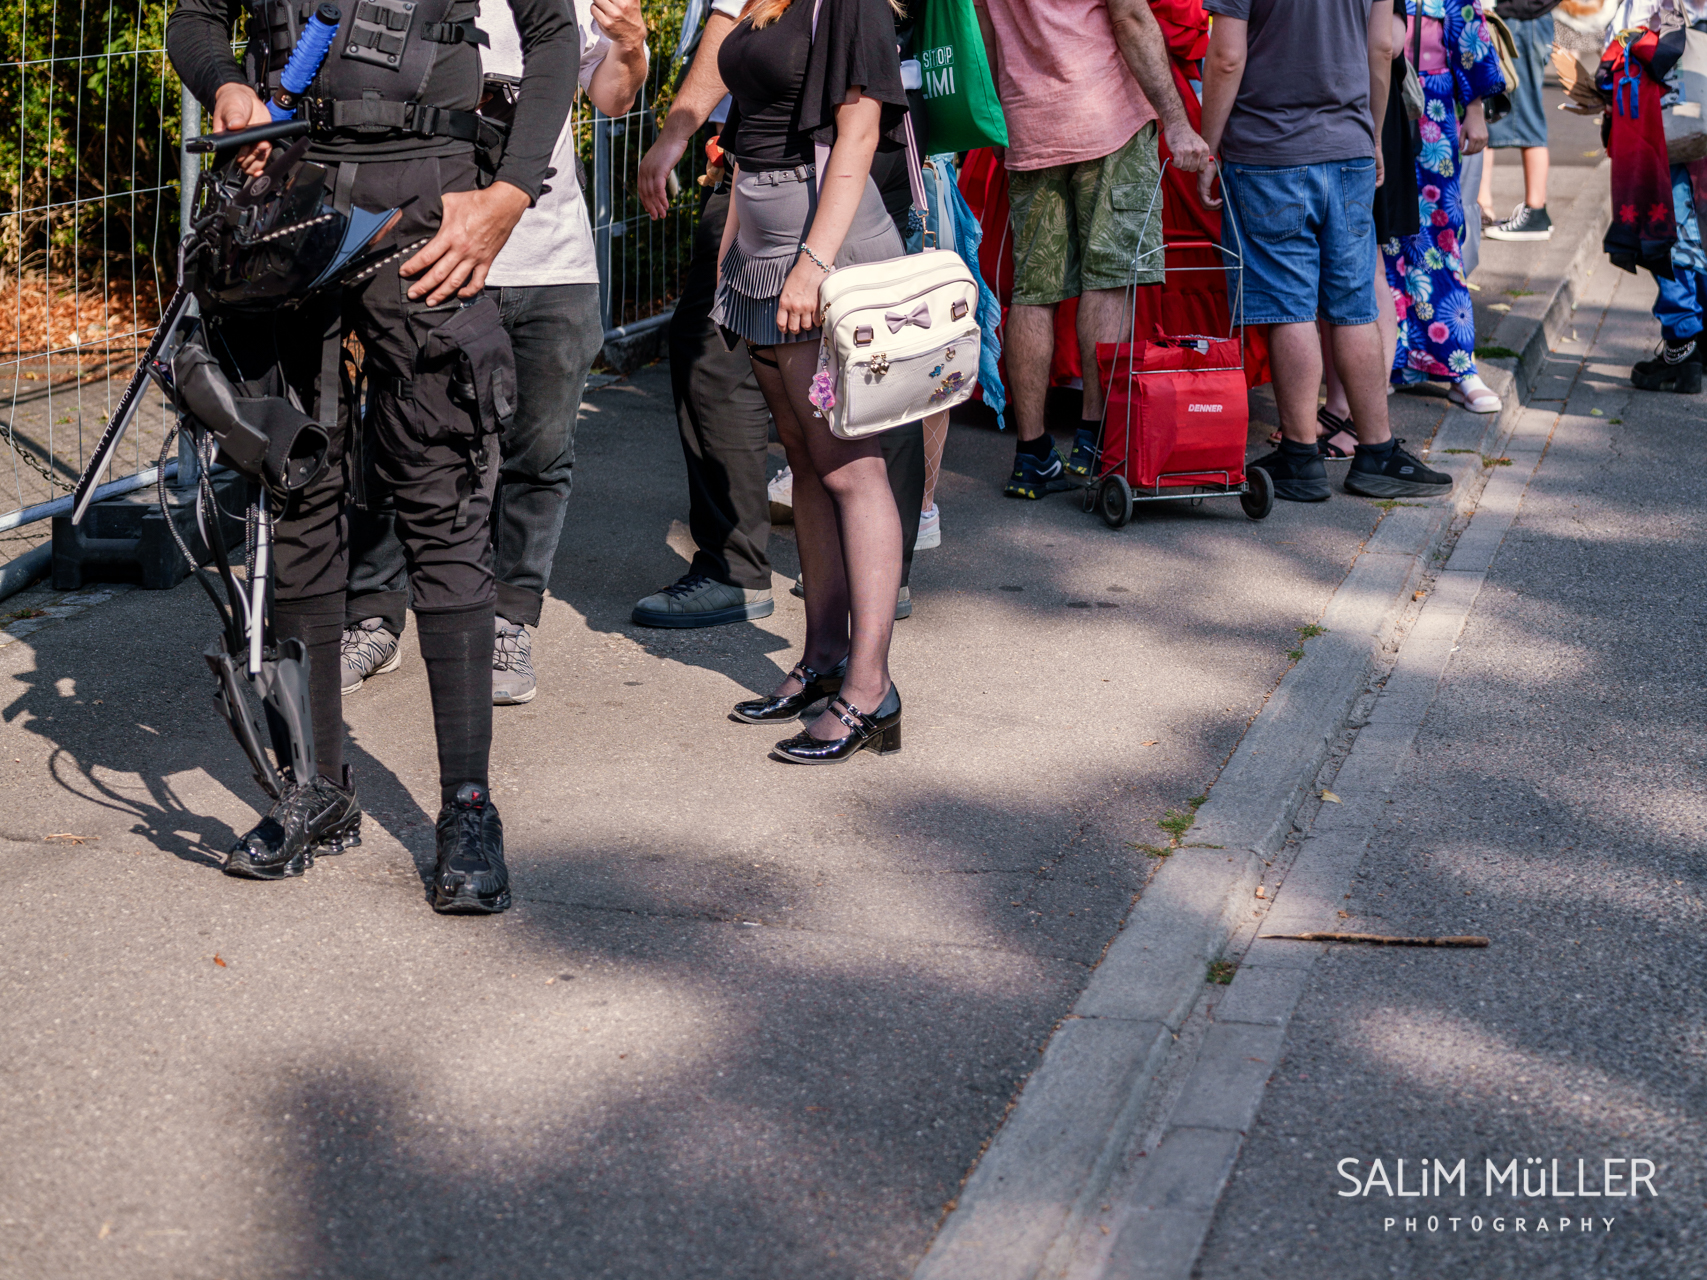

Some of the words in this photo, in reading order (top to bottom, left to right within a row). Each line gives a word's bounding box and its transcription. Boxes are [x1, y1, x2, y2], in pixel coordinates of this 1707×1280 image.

[922, 46, 953, 68] STOP
[922, 66, 956, 100] IMI
[1188, 403, 1223, 413] DENNER
